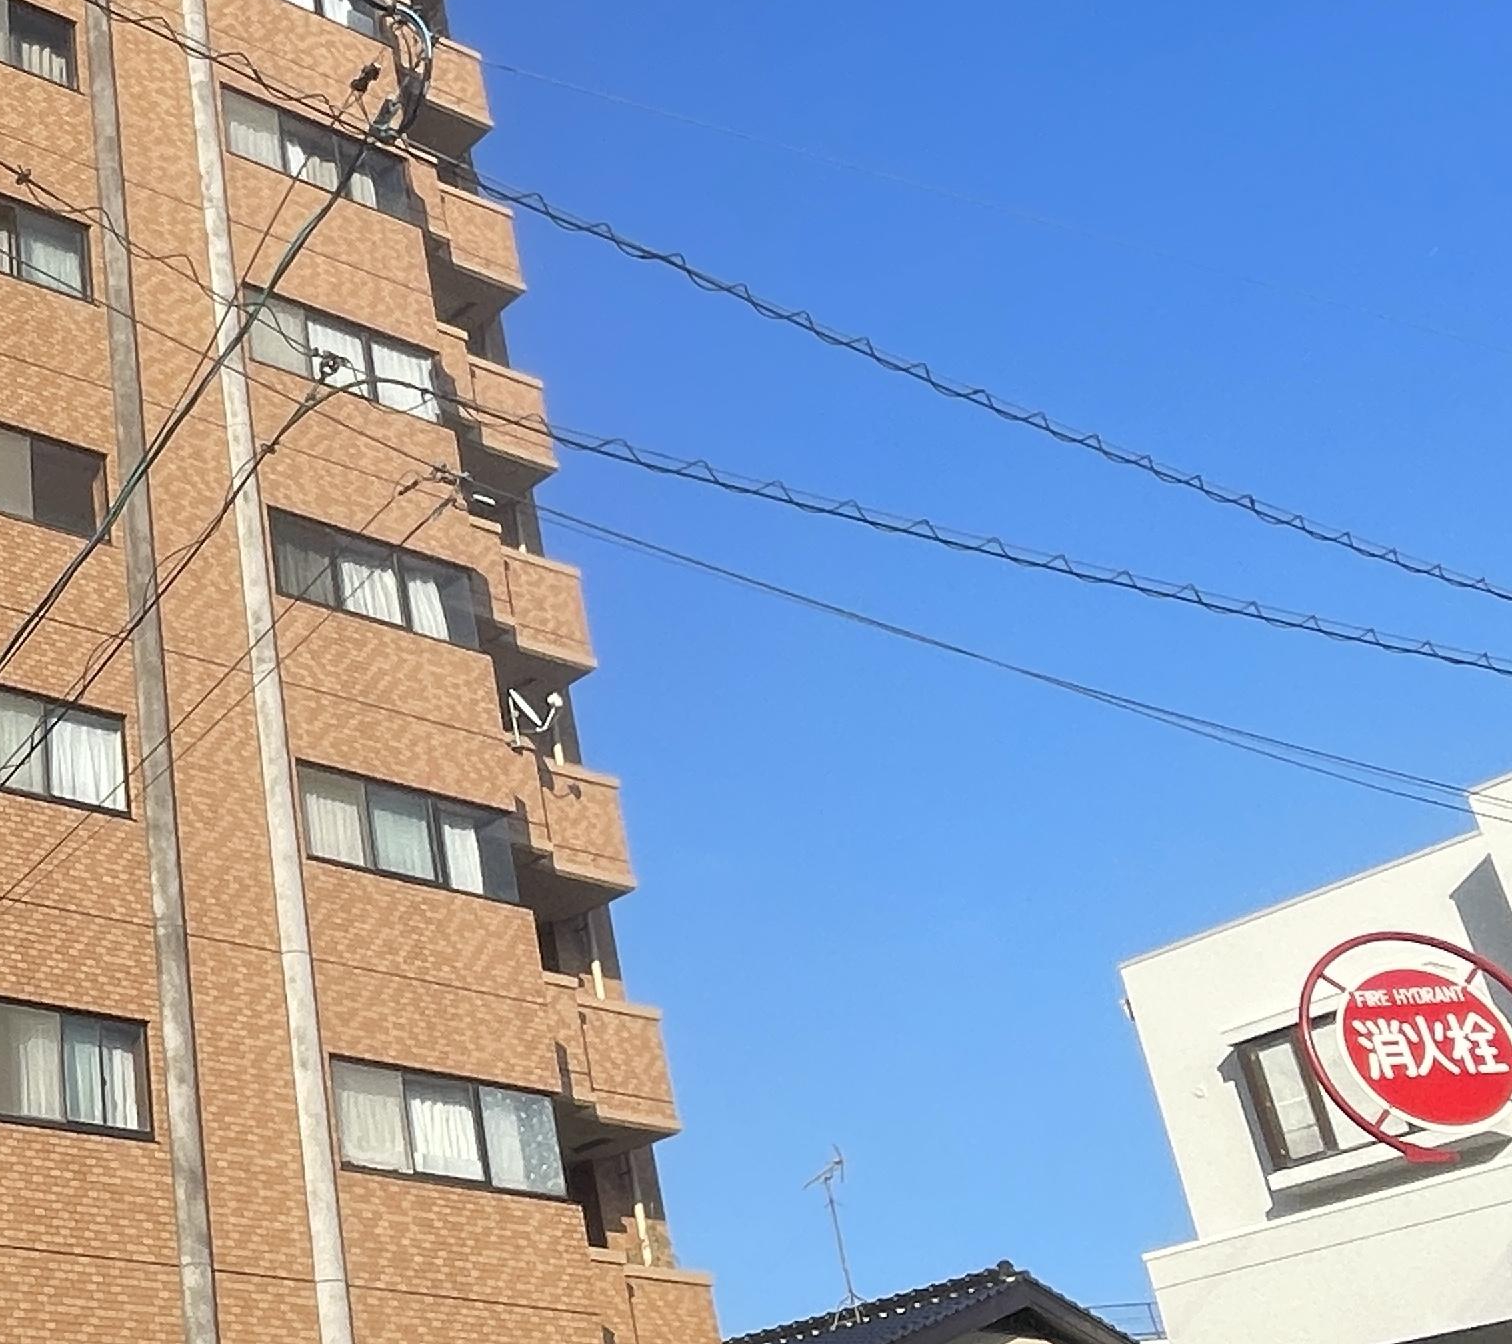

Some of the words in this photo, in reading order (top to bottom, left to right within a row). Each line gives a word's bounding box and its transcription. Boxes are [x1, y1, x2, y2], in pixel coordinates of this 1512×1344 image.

[1352, 989, 1391, 1007] FIRE
[1393, 985, 1466, 1006] HYDRANT
[1351, 1011, 1509, 1080] 消火栓
